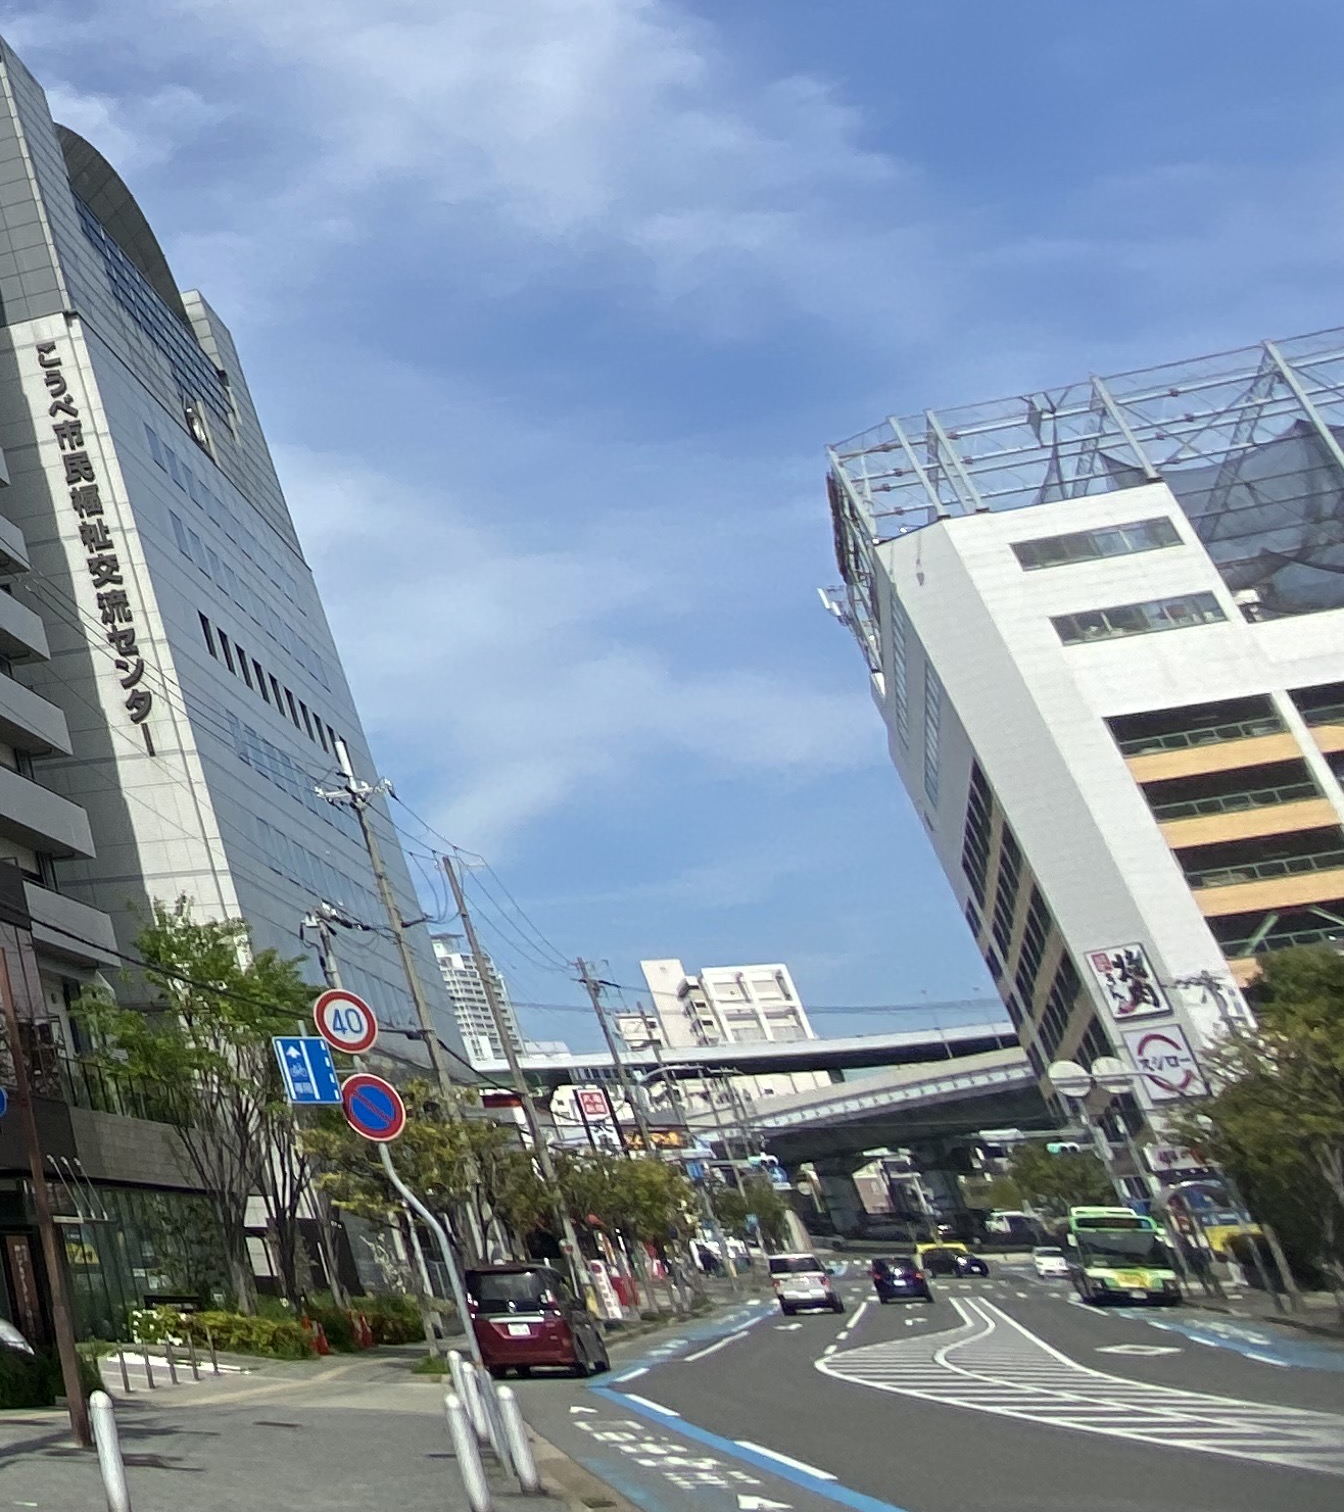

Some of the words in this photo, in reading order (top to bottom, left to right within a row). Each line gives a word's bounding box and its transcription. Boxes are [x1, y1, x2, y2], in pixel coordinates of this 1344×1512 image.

[35, 341, 157, 757] こうべ市民福祉交流センター
[332, 1008, 363, 1035] 40
